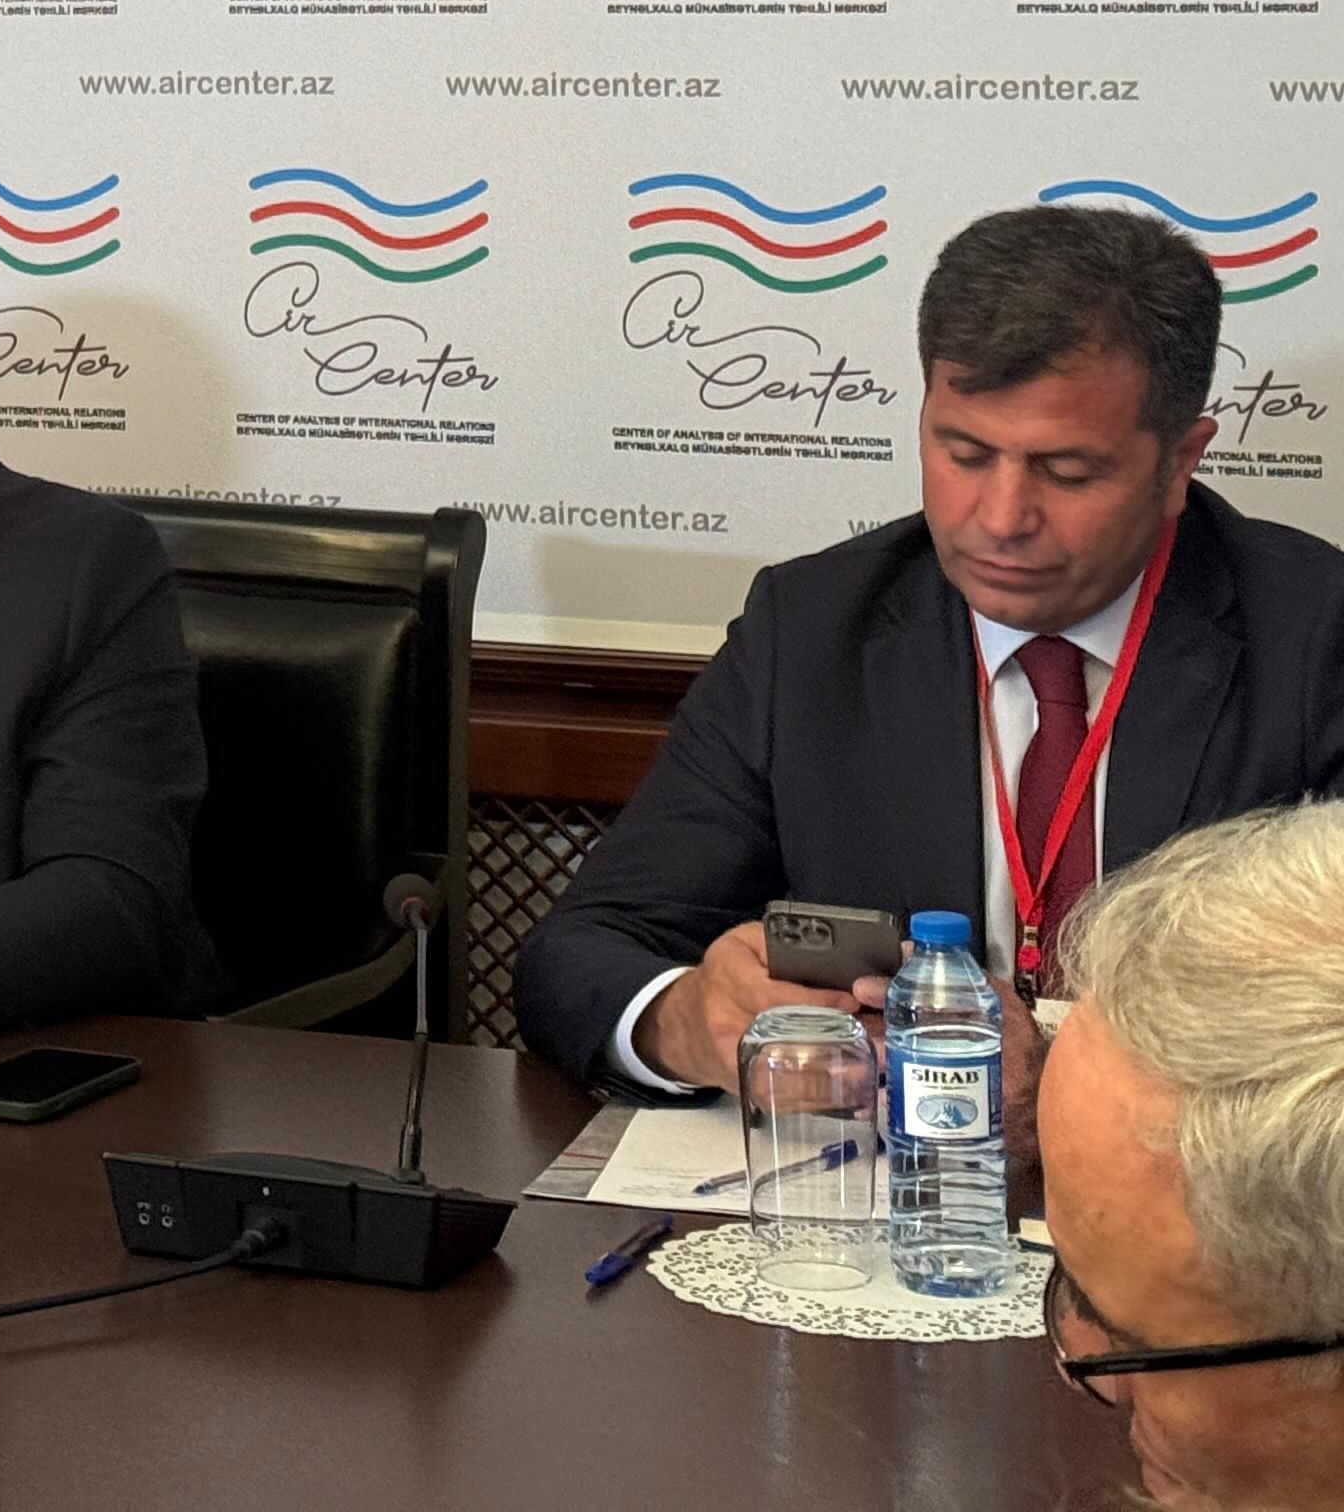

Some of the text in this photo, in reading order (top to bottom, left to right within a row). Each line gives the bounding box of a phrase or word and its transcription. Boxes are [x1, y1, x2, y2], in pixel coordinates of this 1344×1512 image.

[79, 70, 335, 95] www.aircenter.az
[446, 71, 722, 98] www.aircenter.az
[841, 73, 1139, 101] www.aircenter.az
[303, 341, 499, 413] Center
[686, 353, 897, 428] Center
